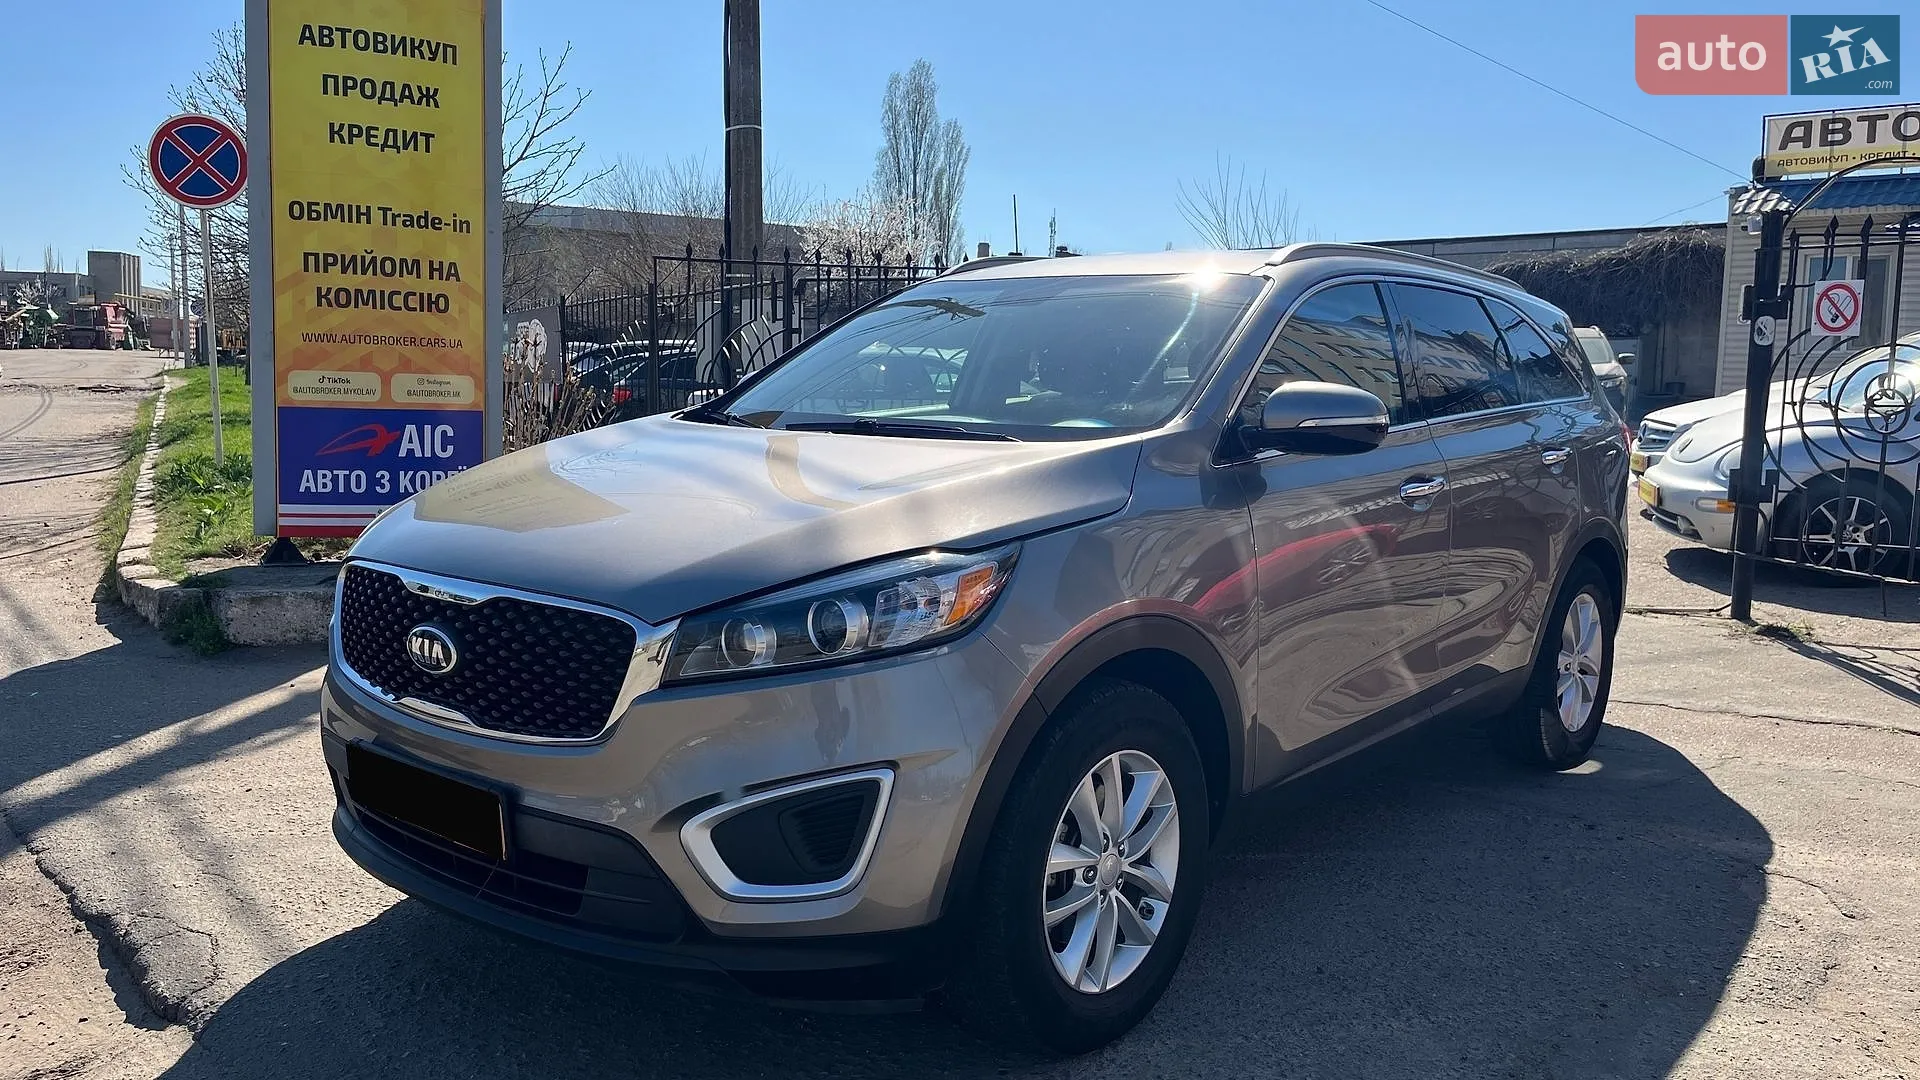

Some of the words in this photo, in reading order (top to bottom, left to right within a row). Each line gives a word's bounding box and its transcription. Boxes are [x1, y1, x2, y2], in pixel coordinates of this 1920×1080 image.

[298, 24, 458, 66] АВТОВИКУП
[322, 74, 440, 109] ПРОДАЖ
[328, 122, 435, 154] КРЕДИТ
[1778, 111, 1920, 150] АВТО
[1777, 154, 1849, 168] АВТОВИКУП
[288, 200, 372, 225] ОБМІН
[377, 206, 471, 234] Trade-in
[302, 249, 421, 280] ПРИЙОМ
[428, 261, 461, 282] НА
[316, 286, 450, 314] КОМІССІЮ
[301, 332, 463, 349] WWW.AUTOBROKER.CARS.UA
[327, 376, 351, 385] TikTok
[299, 469, 367, 493] АВТО
[399, 465, 467, 493] КОР
[411, 635, 447, 667] KIA
